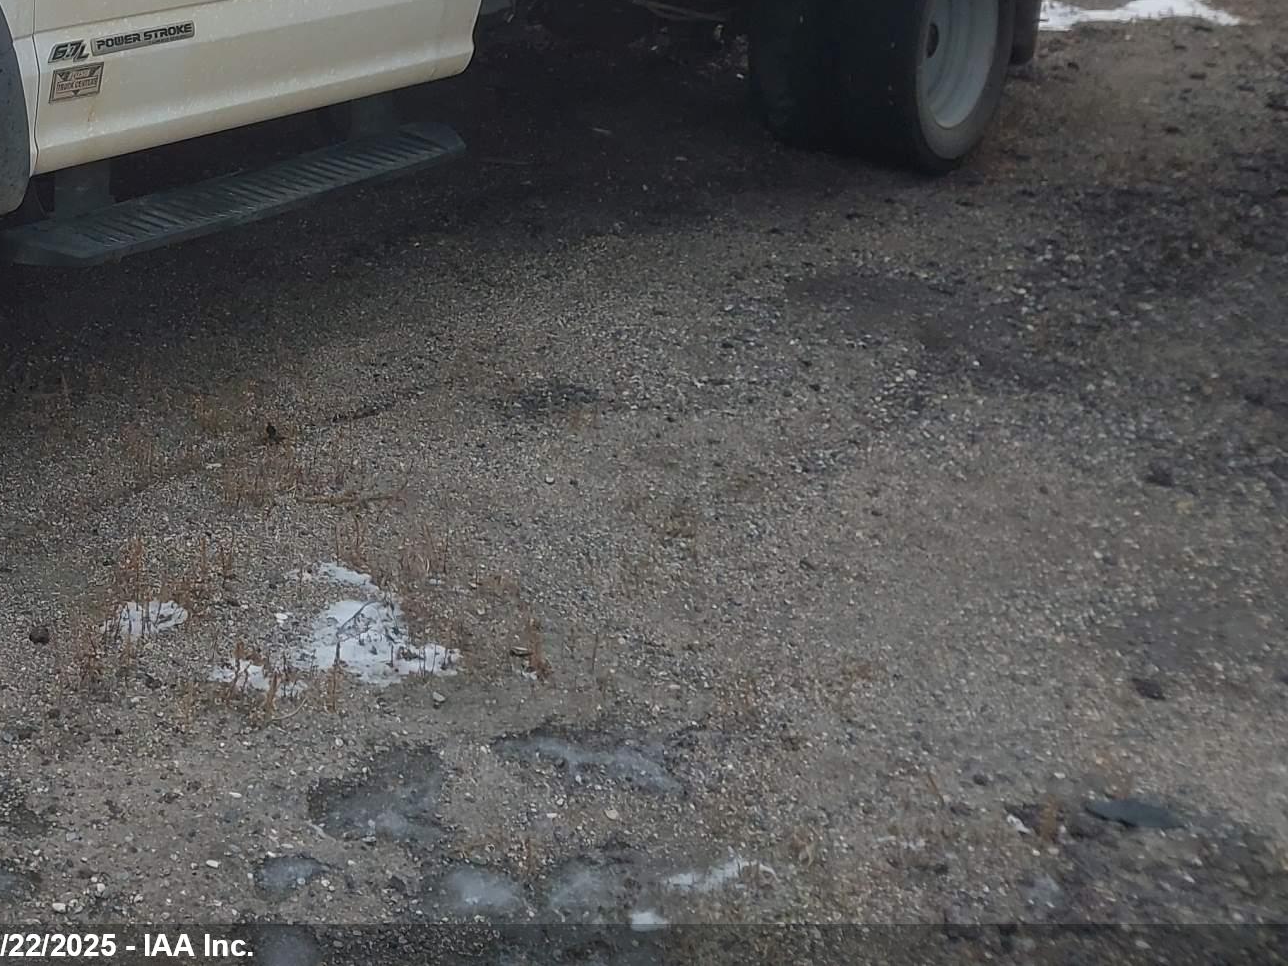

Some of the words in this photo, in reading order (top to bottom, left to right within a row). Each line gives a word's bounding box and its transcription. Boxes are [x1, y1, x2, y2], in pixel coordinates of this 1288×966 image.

[96, 33, 141, 51] POWER
[143, 23, 193, 41] STROKE
[51, 39, 90, 62] 6.7L
